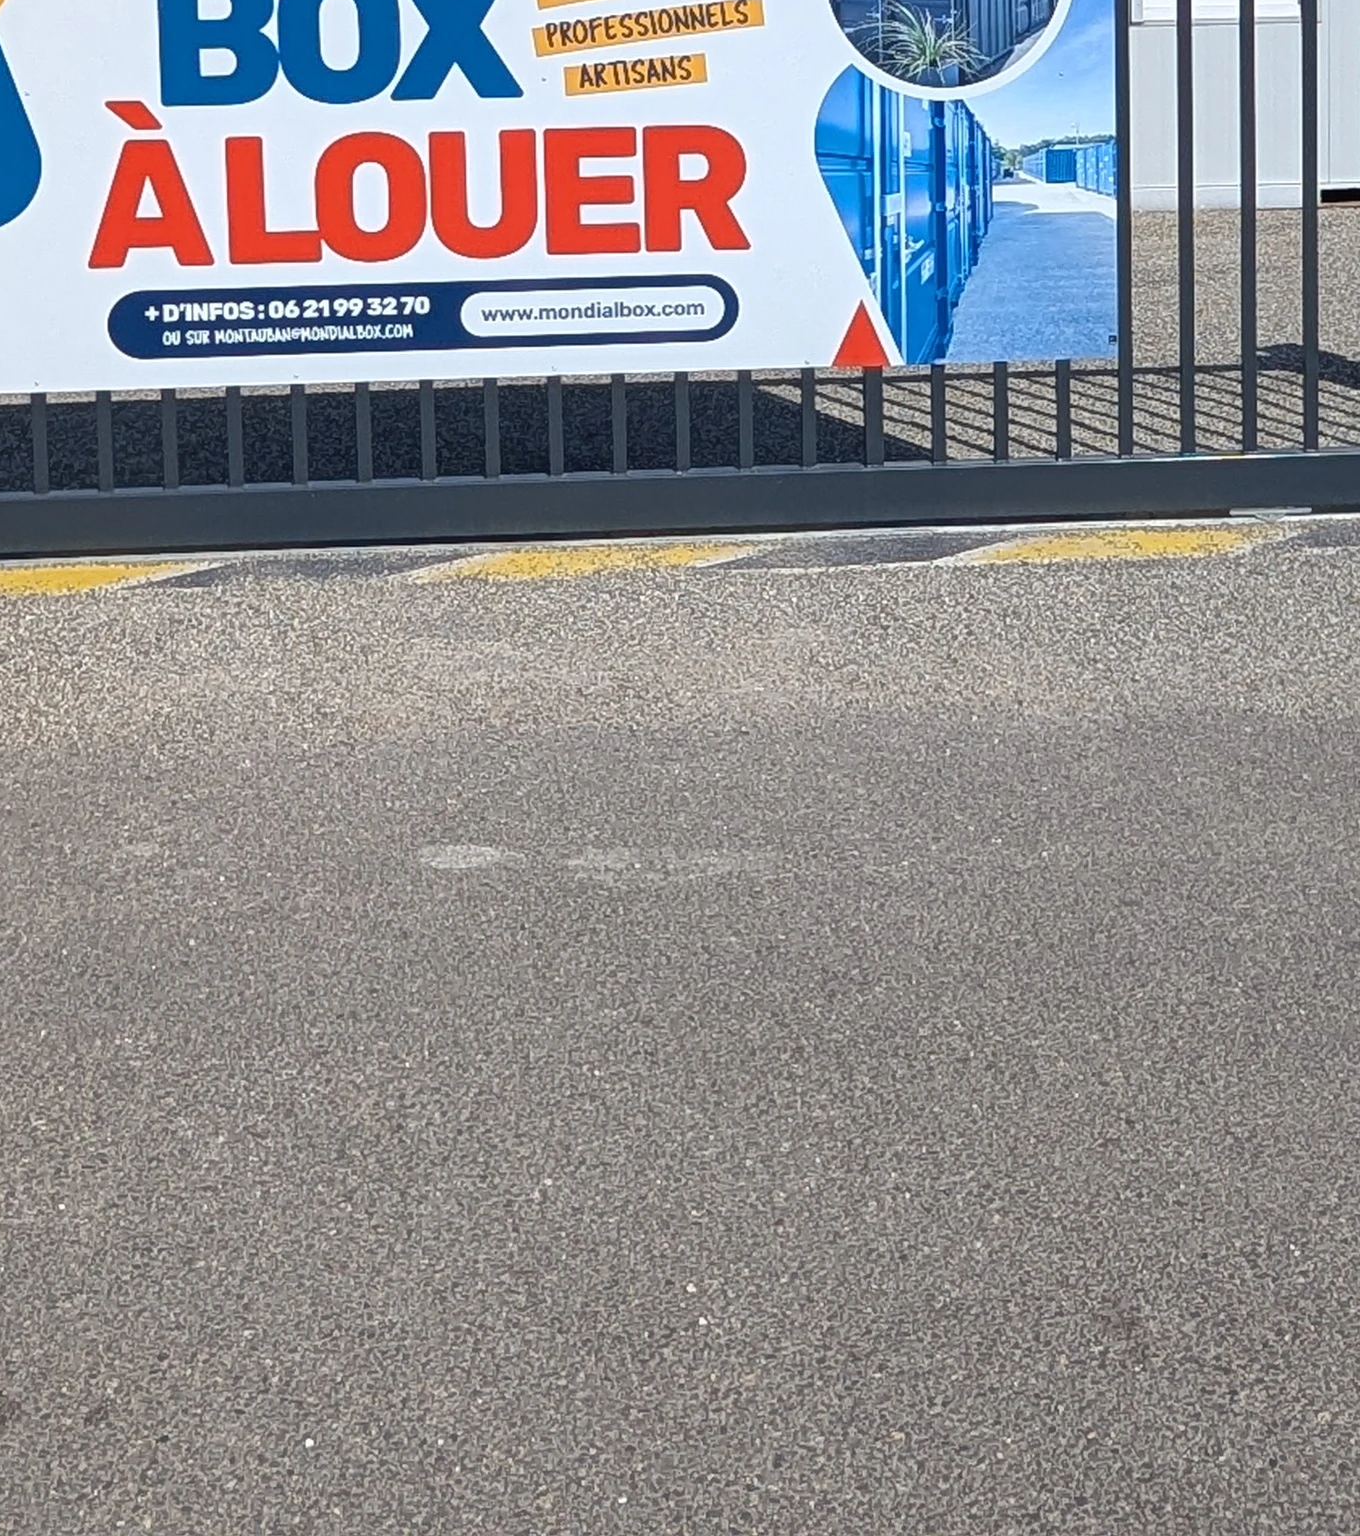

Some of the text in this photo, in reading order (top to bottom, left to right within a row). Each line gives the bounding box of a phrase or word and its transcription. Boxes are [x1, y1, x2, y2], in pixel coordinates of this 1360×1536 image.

[578, 55, 692, 89] ARTISANS
[87, 101, 751, 269] À LOUER
[481, 300, 705, 322] www.mondialbox.com
[163, 324, 414, 346] OU SUR MONTAUBAN@MONDIALBOX.COM
